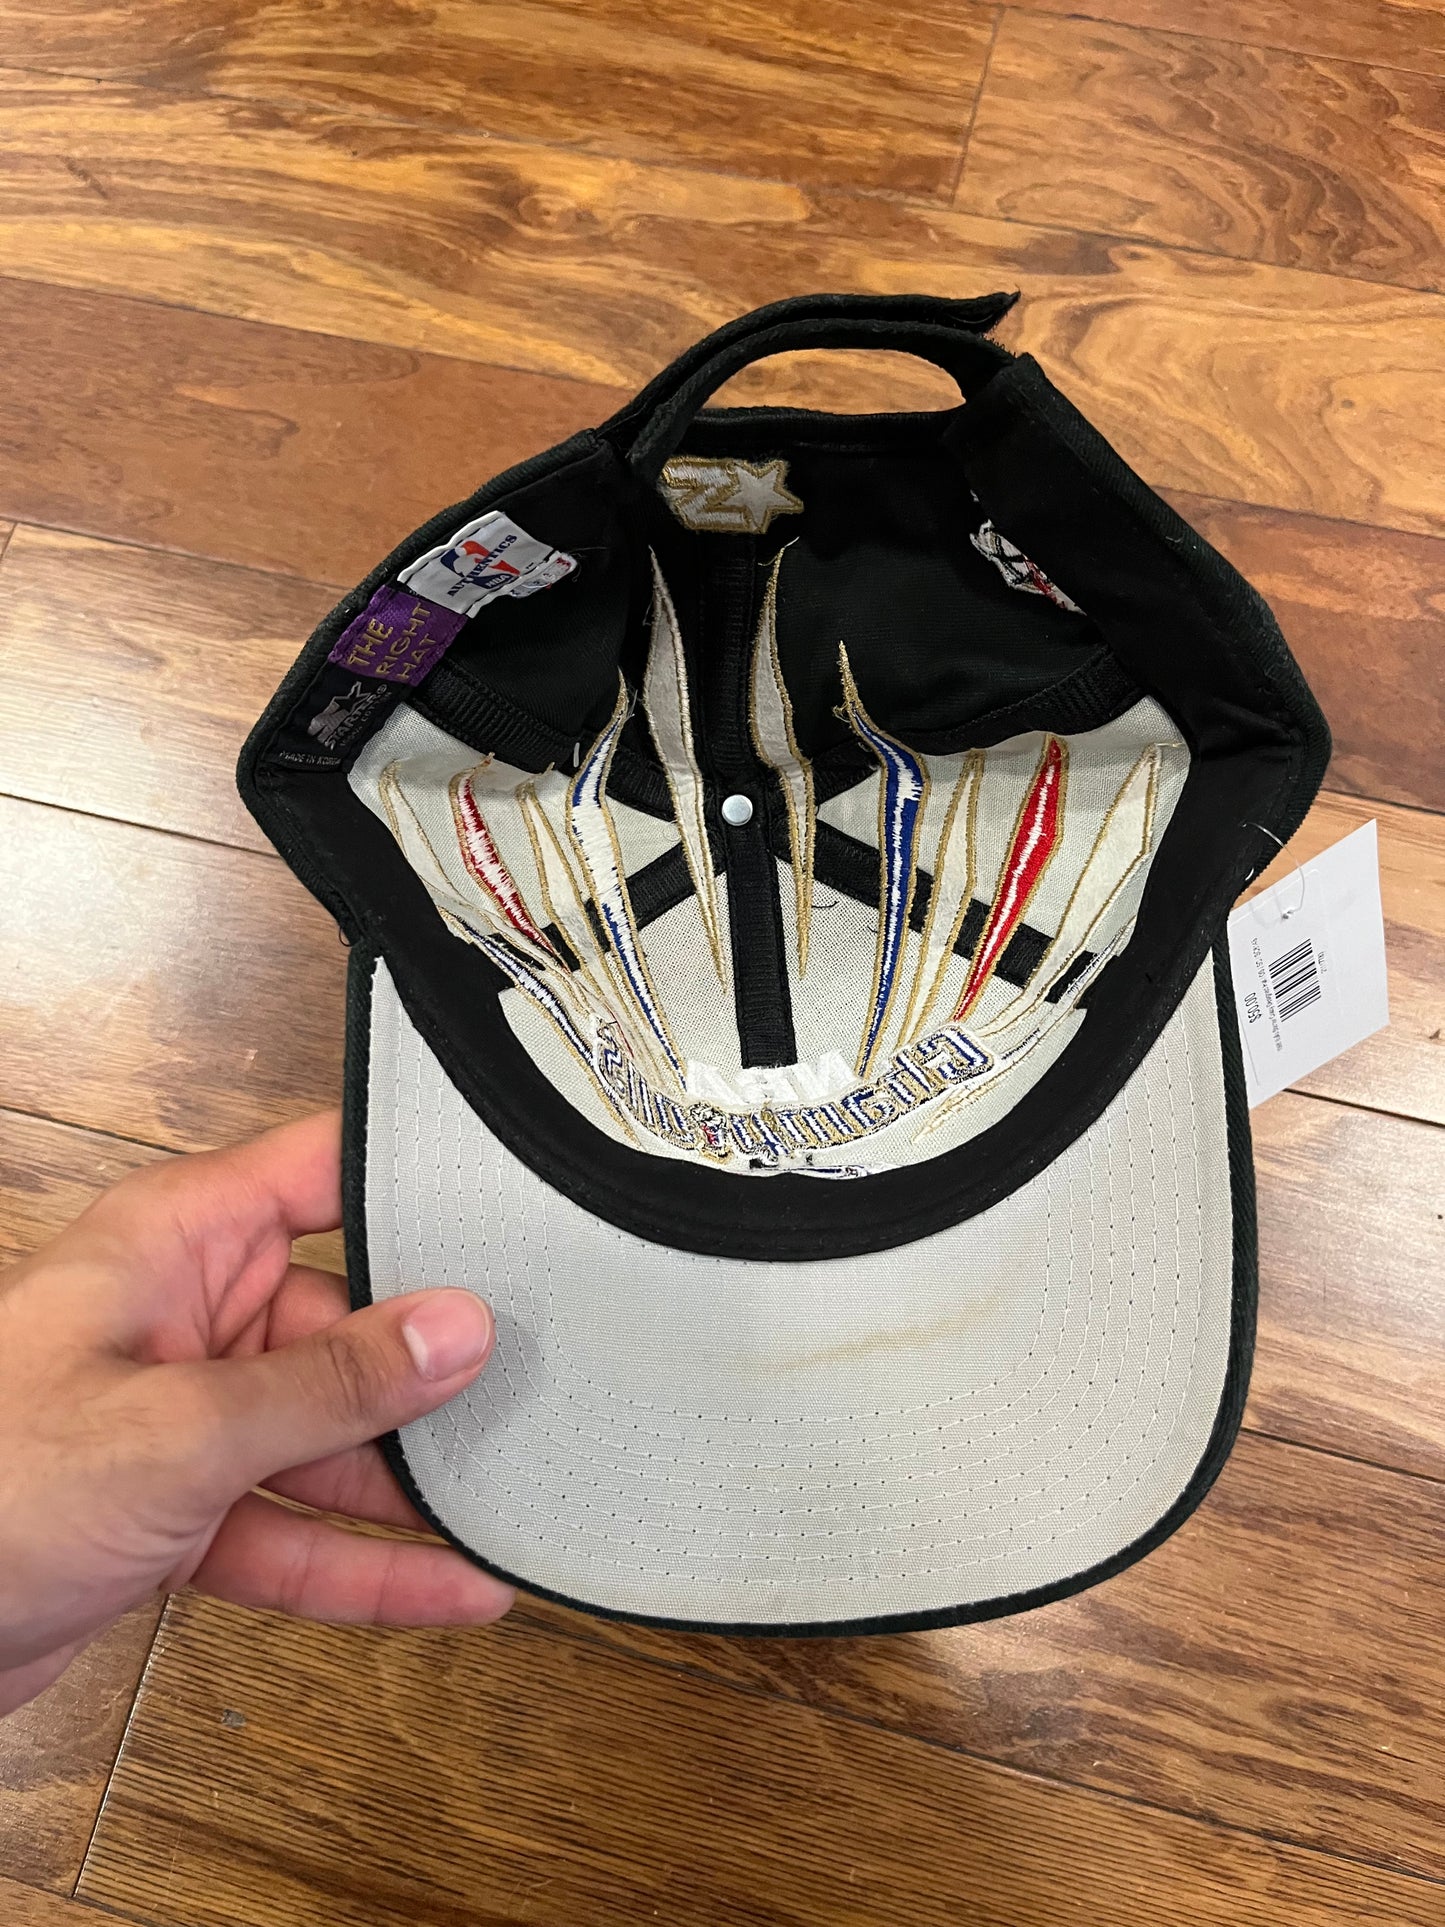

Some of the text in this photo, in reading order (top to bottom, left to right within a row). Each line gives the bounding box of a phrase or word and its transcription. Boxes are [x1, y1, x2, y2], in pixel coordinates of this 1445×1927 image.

[447, 534, 518, 597] AUTHENTICS
[485, 573, 511, 588] NBA
[347, 618, 394, 667] THE
[375, 602, 431, 675] RIGHT
[397, 632, 437, 680] HAT
[1244, 992, 1262, 1024] $50.00
